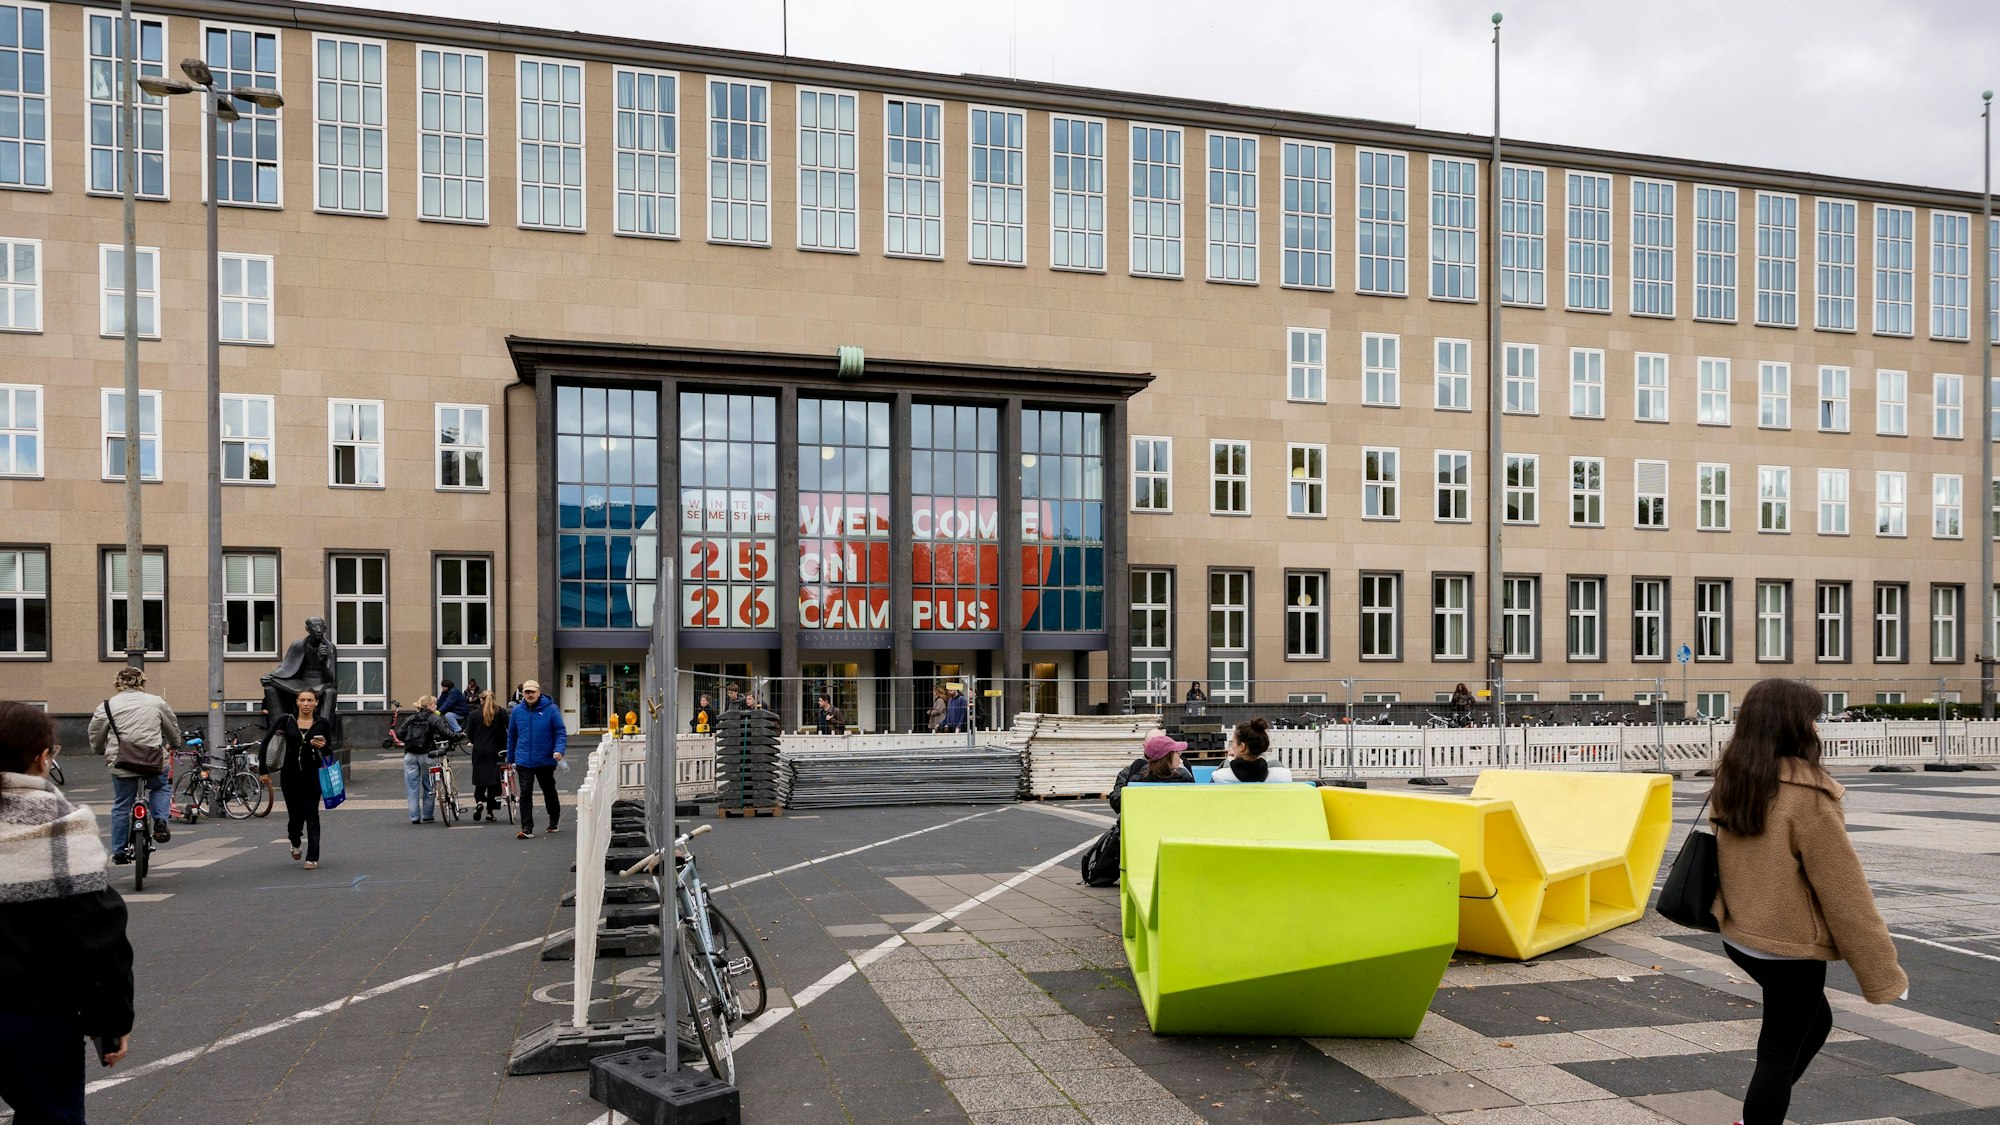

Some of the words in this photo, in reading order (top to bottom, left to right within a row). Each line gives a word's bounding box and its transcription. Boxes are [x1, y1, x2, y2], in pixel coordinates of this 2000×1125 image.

[687, 510, 771, 521] SEMESTER
[688, 499, 765, 510] WINTER
[800, 505, 1039, 539] WELCOME
[690, 540, 769, 580] 25
[799, 552, 858, 583] ON
[690, 587, 770, 626] 26
[799, 599, 991, 630] CAMPUS
